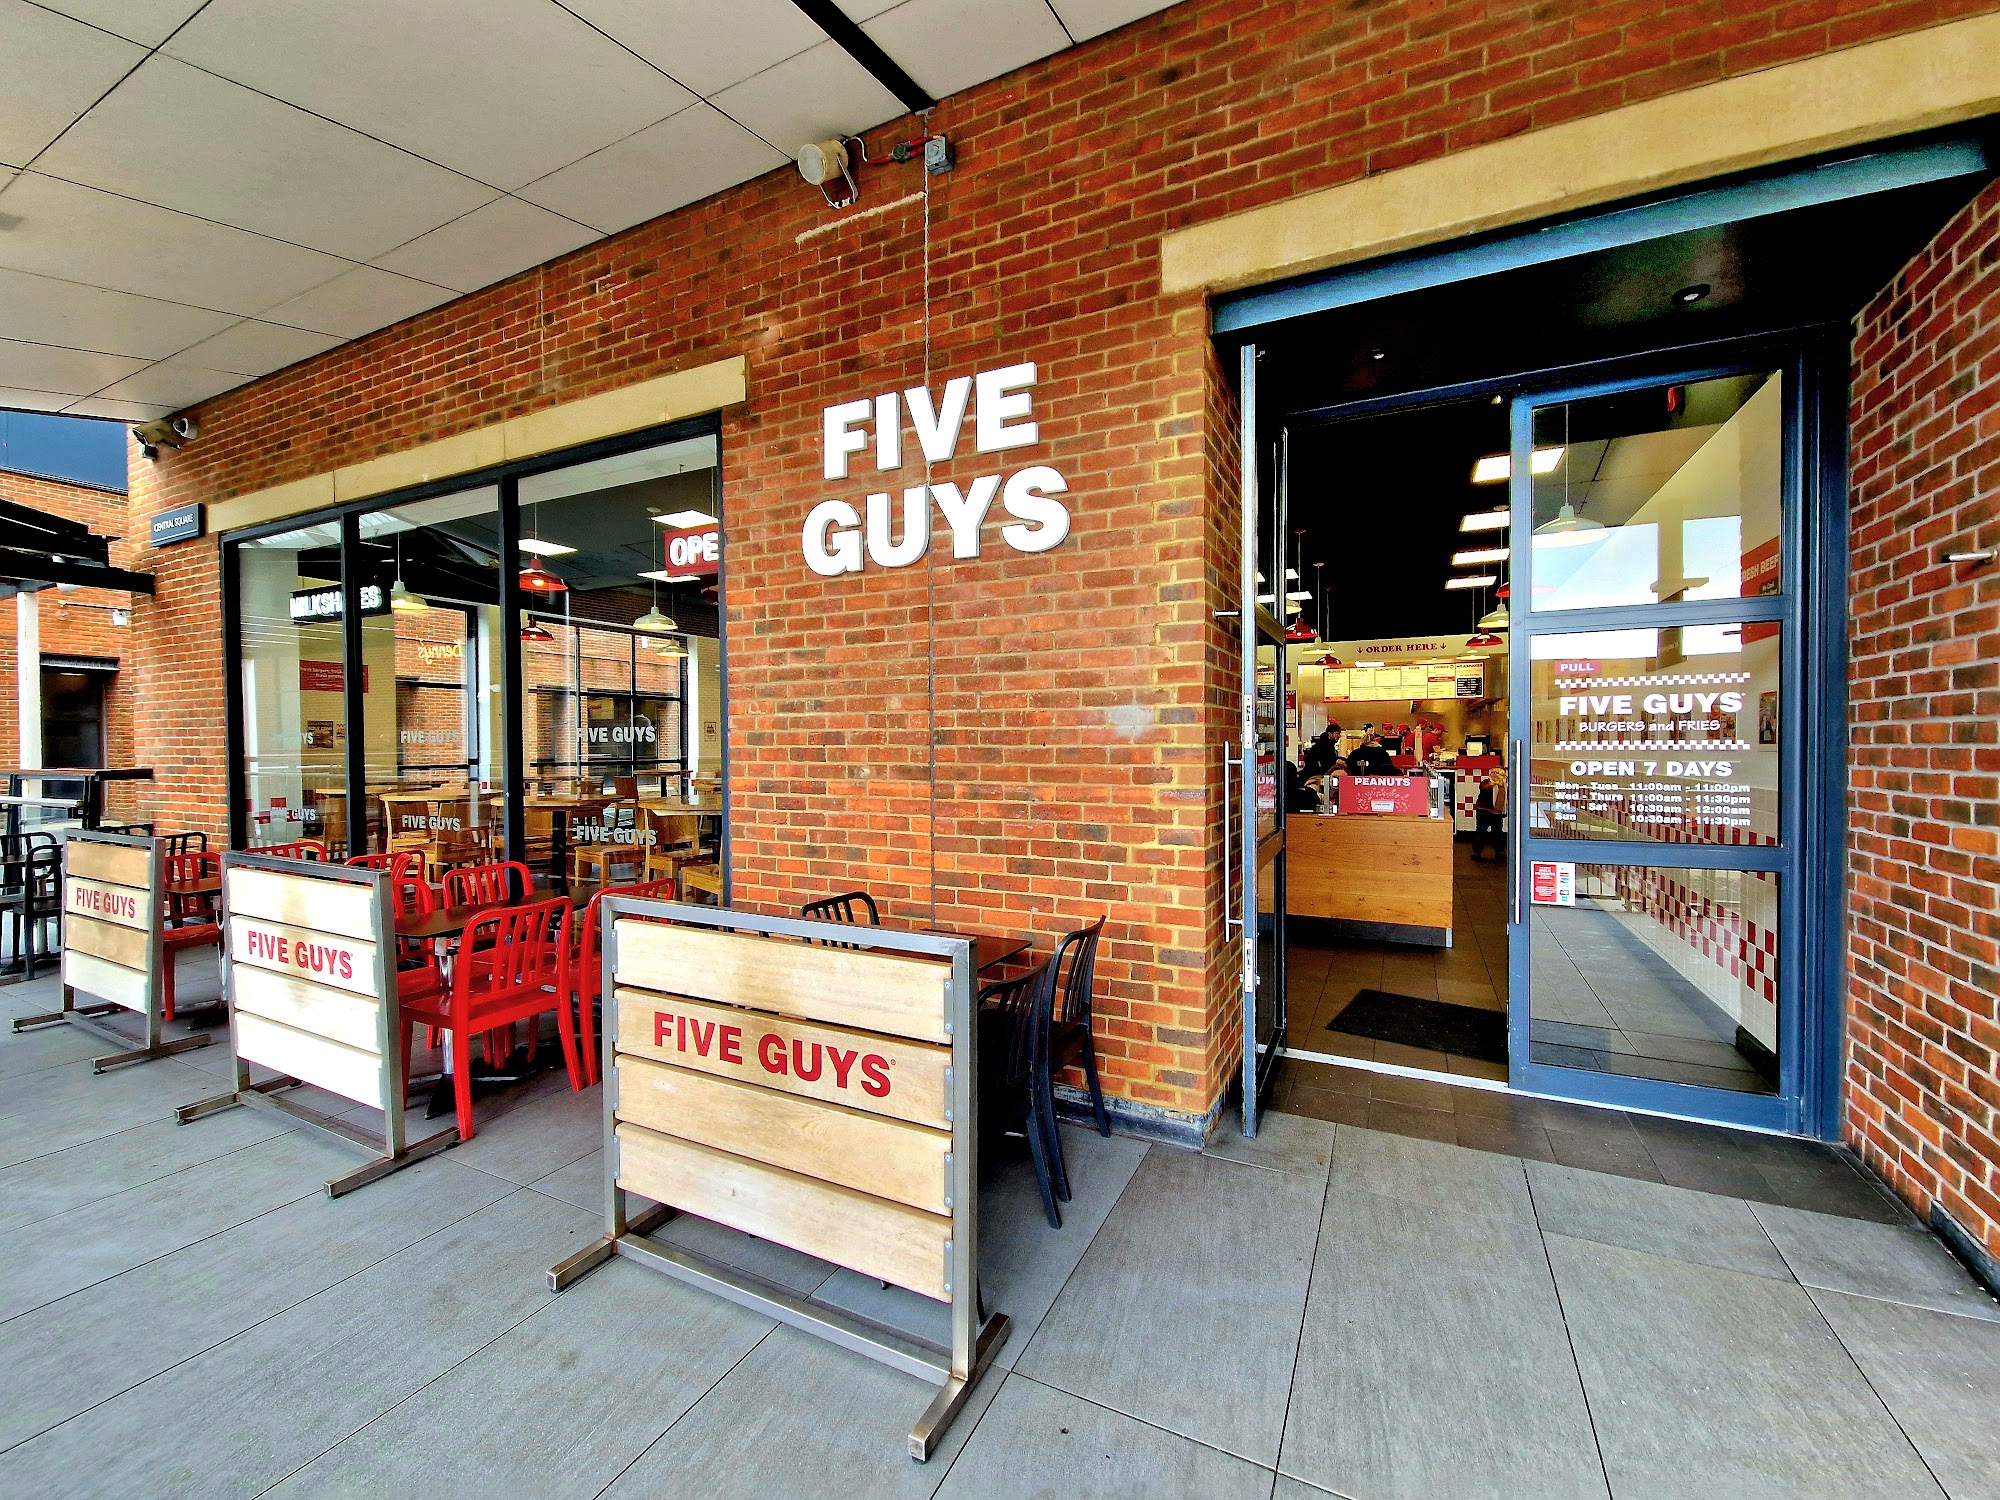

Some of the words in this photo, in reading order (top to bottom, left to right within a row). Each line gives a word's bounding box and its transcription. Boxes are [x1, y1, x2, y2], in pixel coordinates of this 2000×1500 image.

[823, 361, 1038, 480] FIVE
[153, 519, 175, 533] CENTRAL
[174, 513, 194, 527] SQUARE
[801, 465, 1071, 577] GUYS
[669, 531, 719, 567] OPE
[290, 585, 382, 618] MILKSHES
[1366, 645, 1402, 653] ORDER
[1406, 643, 1437, 651] HERE
[1560, 663, 1594, 672] PULL
[1560, 695, 1632, 716] FIVE
[1643, 692, 1743, 714] GUYS
[577, 727, 608, 742] FIVE
[612, 726, 656, 742] GUYS
[1579, 721, 1645, 733] BURGERS
[1649, 720, 1674, 732] and
[1678, 720, 1721, 731] FRIES
[400, 730, 425, 743] FIVE
[428, 730, 459, 745] GUYS
[1570, 761, 1635, 776] OPEN
[1643, 761, 1658, 776] 7
[1666, 761, 1733, 776] DAYS
[1354, 777, 1411, 787] PEANUTS
[1555, 782, 1579, 790] Mon
[1590, 782, 1619, 790] Tues
[1629, 783, 1682, 792] 11:00am
[1695, 783, 1750, 794] 11:00pm
[1555, 792, 1580, 800] Wed
[1590, 792, 1624, 801] Thurs
[1629, 794, 1682, 802] 11:00am
[1695, 795, 1750, 805] 11:30pm
[1555, 802, 1571, 810] Fri
[1588, 803, 1608, 811] Sat
[1629, 804, 1682, 813] 10:30am
[1695, 806, 1750, 815] 12:00am
[402, 814, 426, 829] FIVE
[429, 816, 460, 832] GUYS
[1555, 812, 1577, 821] Sun
[1629, 814, 1682, 824] 10:30am
[1695, 816, 1750, 827] 11:30pm
[577, 825, 609, 842] FIVE
[614, 827, 658, 845] GUYS
[76, 887, 100, 911] FIVE
[103, 892, 136, 919] GUYS
[248, 930, 289, 964] FIVE
[296, 941, 353, 979] GUYS
[654, 1011, 743, 1065] FIVE
[758, 1033, 891, 1097] GUYS
